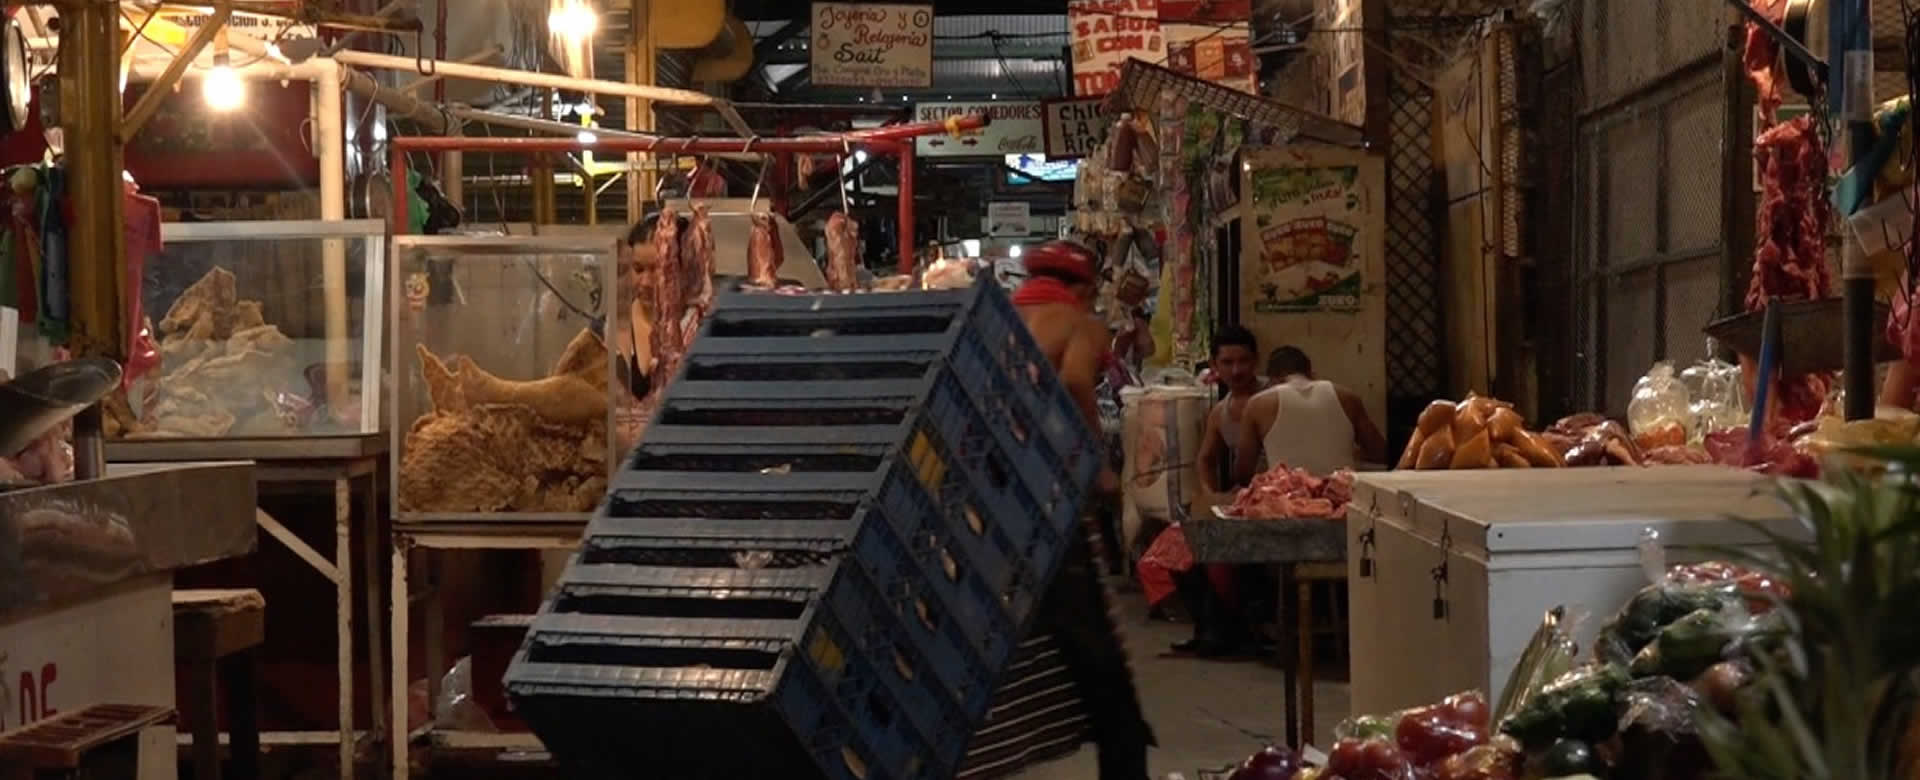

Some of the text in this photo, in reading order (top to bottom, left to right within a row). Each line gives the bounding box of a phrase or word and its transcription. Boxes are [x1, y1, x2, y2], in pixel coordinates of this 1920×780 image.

[1076, 17, 1161, 38] SABOR
[1096, 35, 1144, 53] CON
[920, 104, 1041, 120] SECTOR COMEDORES
[1061, 121, 1089, 136] LA
